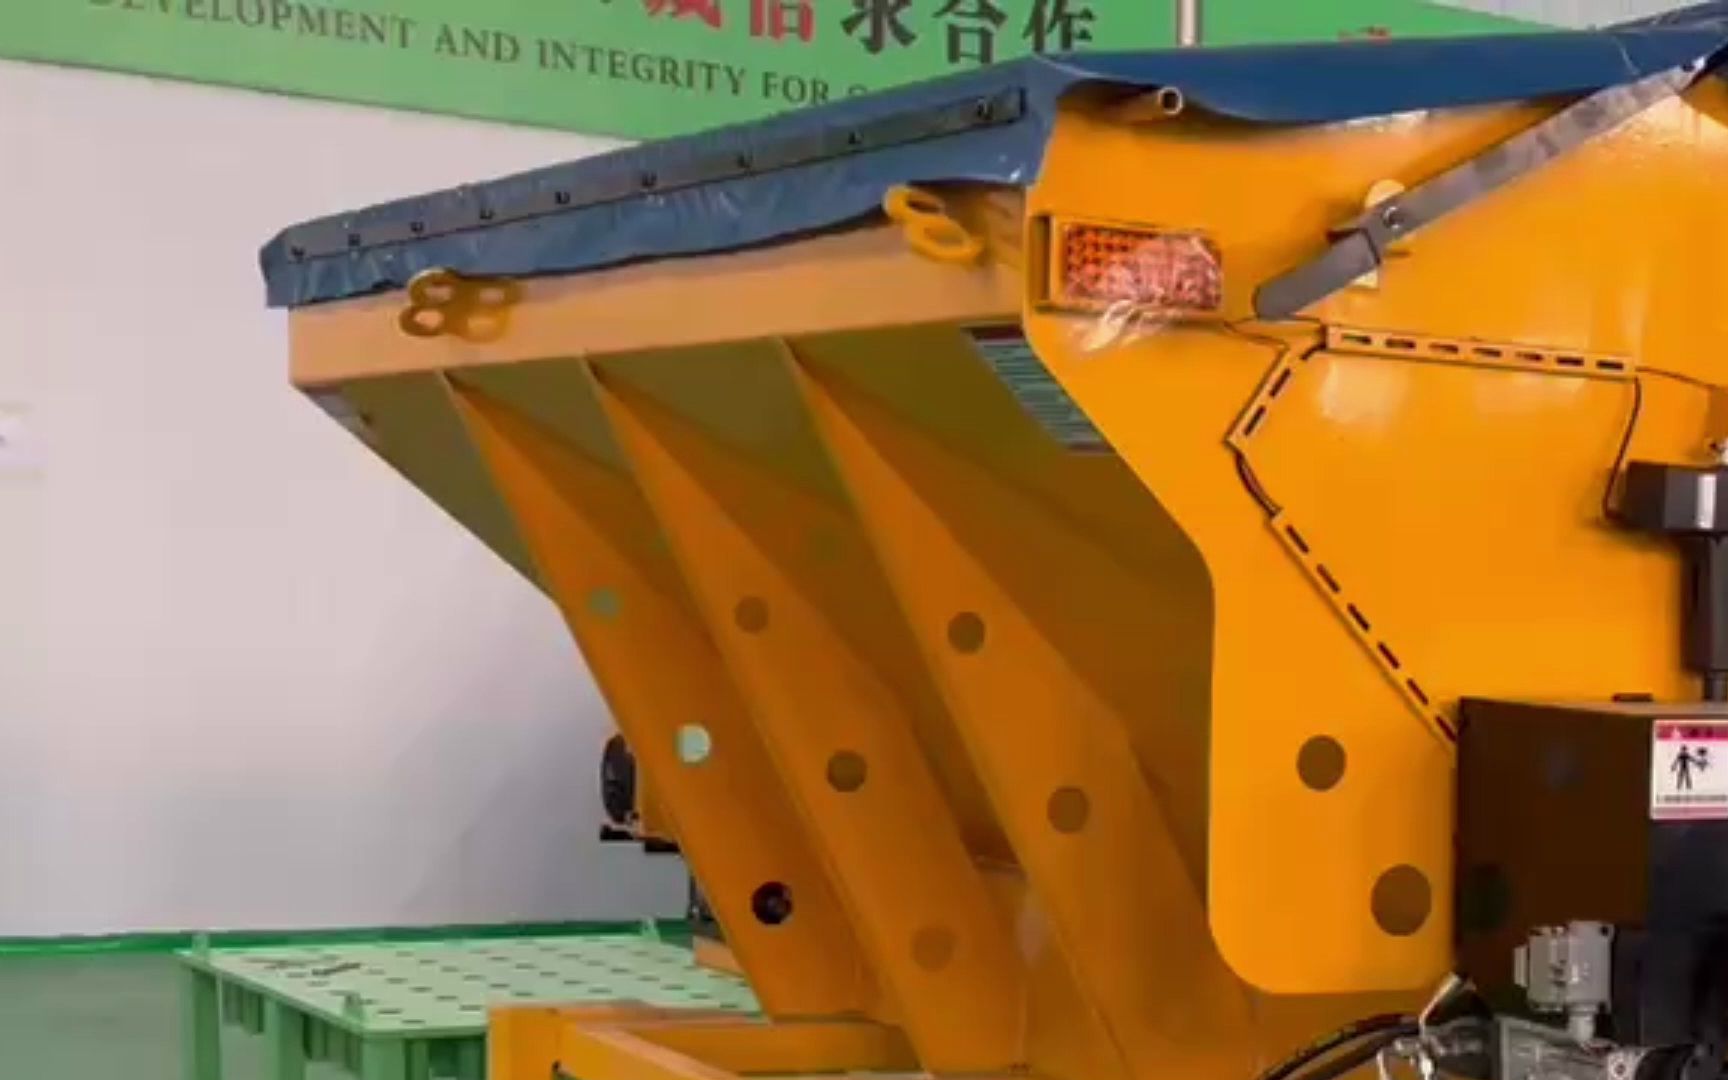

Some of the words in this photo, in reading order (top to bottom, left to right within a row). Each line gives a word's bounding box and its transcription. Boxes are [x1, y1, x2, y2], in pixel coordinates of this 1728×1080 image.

[90, 0, 417, 49] ELOPMENT
[434, 22, 521, 63] AND
[536, 38, 747, 96] INTEGRITY
[761, 70, 829, 105] FOR
